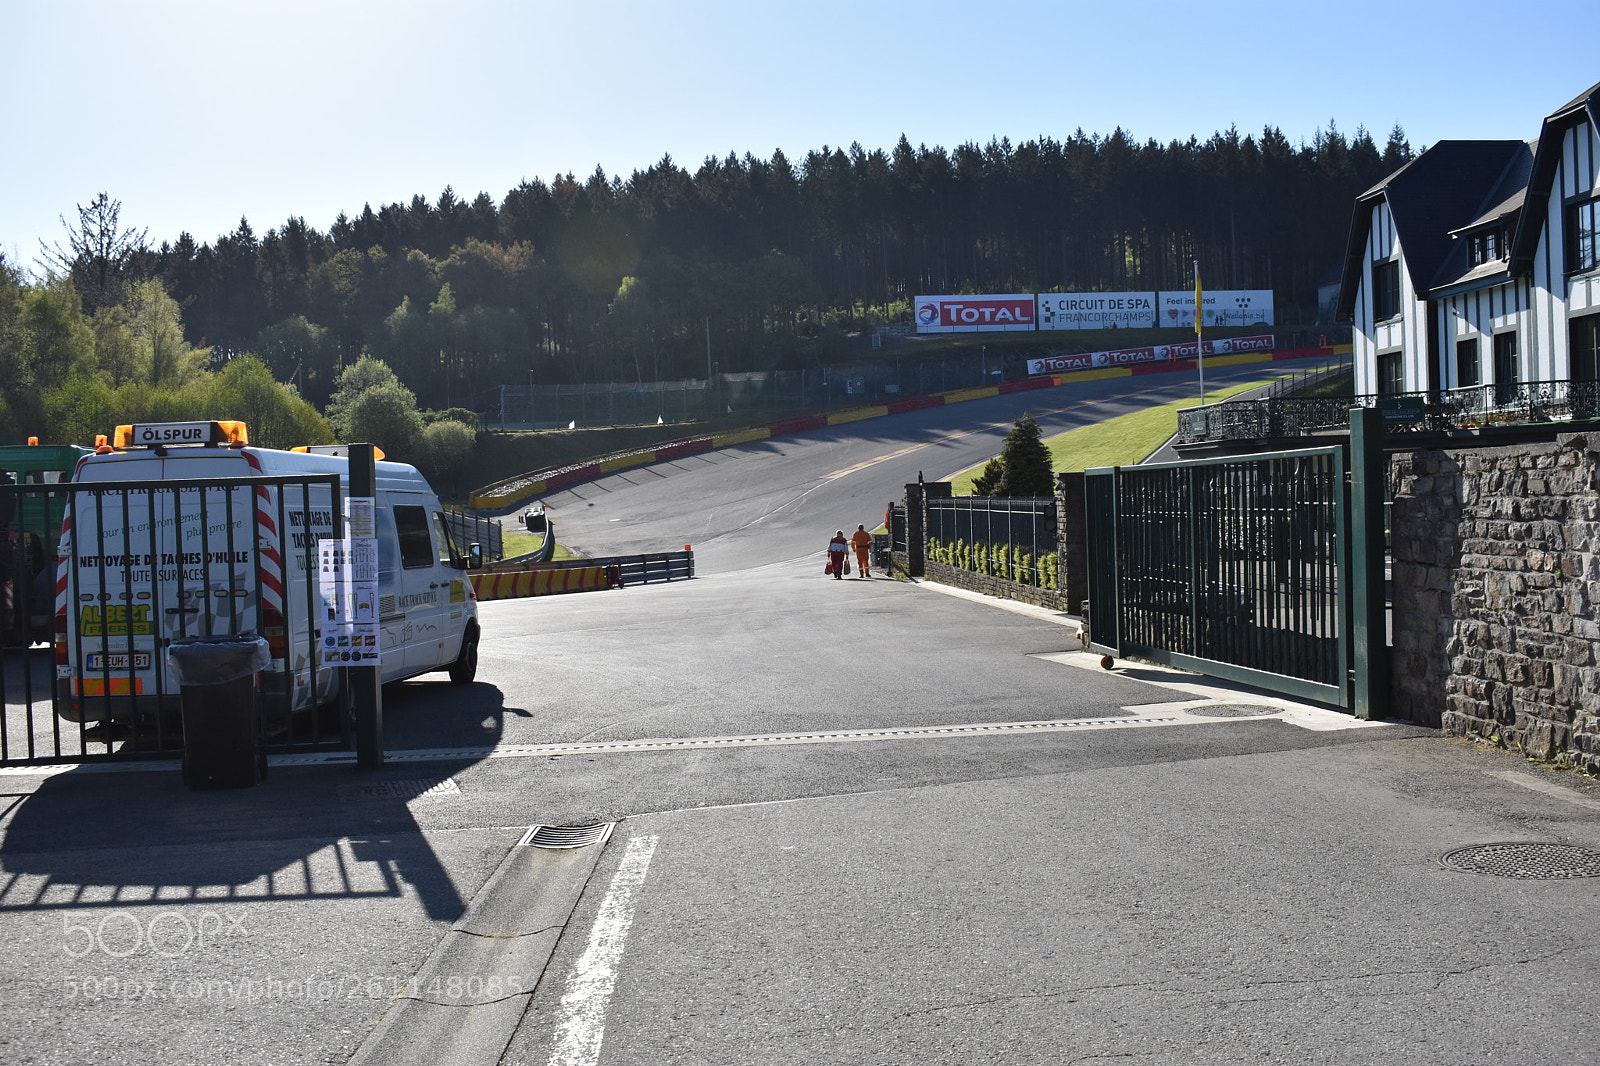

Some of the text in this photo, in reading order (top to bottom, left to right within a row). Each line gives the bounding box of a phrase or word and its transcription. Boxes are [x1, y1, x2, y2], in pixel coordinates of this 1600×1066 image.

[1059, 298, 1151, 311] CIRCUIT DE SPA
[1166, 297, 1216, 305] Feel insred
[944, 304, 1031, 323] TOTAL
[1059, 310, 1153, 323] FRANCORCHAMPS
[1171, 345, 1213, 356] TOTAL
[1232, 339, 1272, 350] TOTAL
[1110, 351, 1154, 363] TOTAL
[1046, 358, 1091, 370] TOTAL
[142, 427, 203, 441] ÖLSPUR
[88, 488, 124, 497] RCE
[130, 487, 175, 495] TRCK
[288, 510, 324, 527] NETTAGE
[97, 527, 119, 542] our
[186, 519, 242, 541] plu prore
[80, 553, 141, 568] NETOYAGE
[144, 553, 158, 566] D
[161, 552, 202, 565] TAHES
[120, 568, 207, 583] TUTE SURACES
[94, 655, 148, 667] 1-EUH-51
